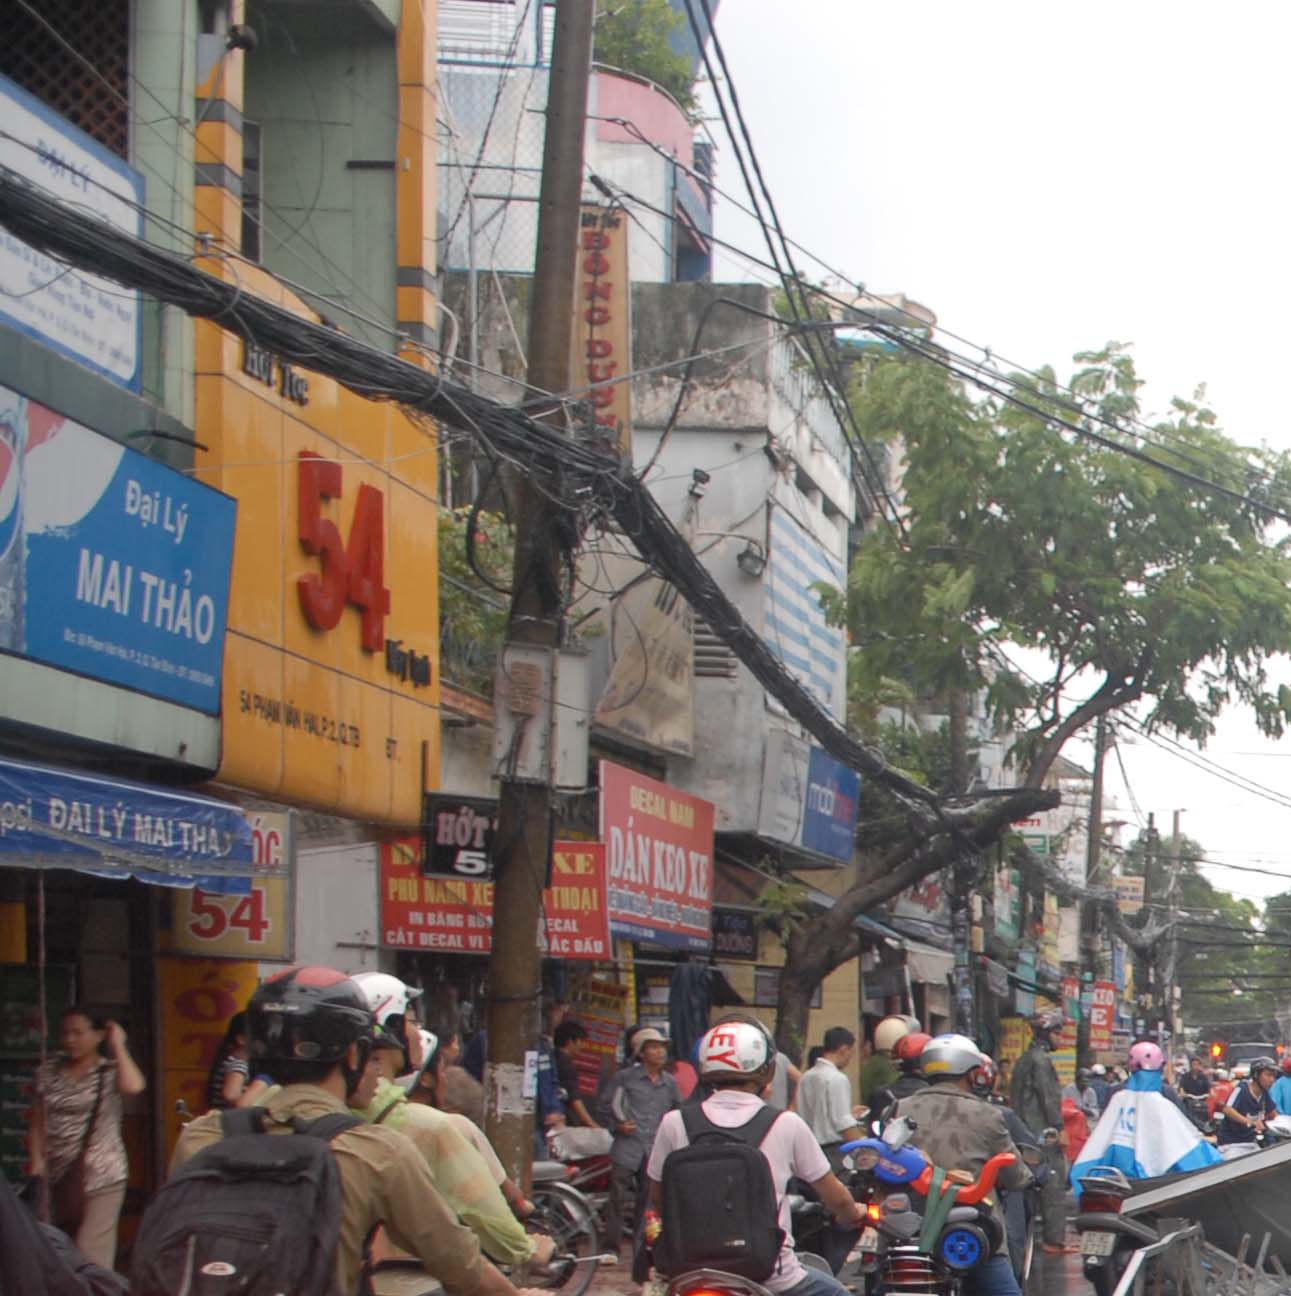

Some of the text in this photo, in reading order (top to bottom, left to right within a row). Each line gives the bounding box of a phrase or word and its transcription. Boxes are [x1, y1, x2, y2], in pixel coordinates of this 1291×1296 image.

[124, 479, 190, 545] Đại Lý
[298, 449, 392, 654] 54
[76, 548, 215, 645] MAI THẢO
[97, 801, 128, 840] LÝ
[133, 812, 174, 848] MAI
[436, 805, 489, 849] HỚT
[629, 785, 668, 822] DECAL
[252, 817, 281, 870] ÓC
[552, 852, 595, 876] XE
[609, 815, 710, 901] DÁN KEO XE
[188, 888, 270, 943] 54
[409, 911, 424, 925] IN
[473, 882, 495, 907] XE
[552, 886, 599, 915] THOẠI
[419, 931, 463, 949] DECAL
